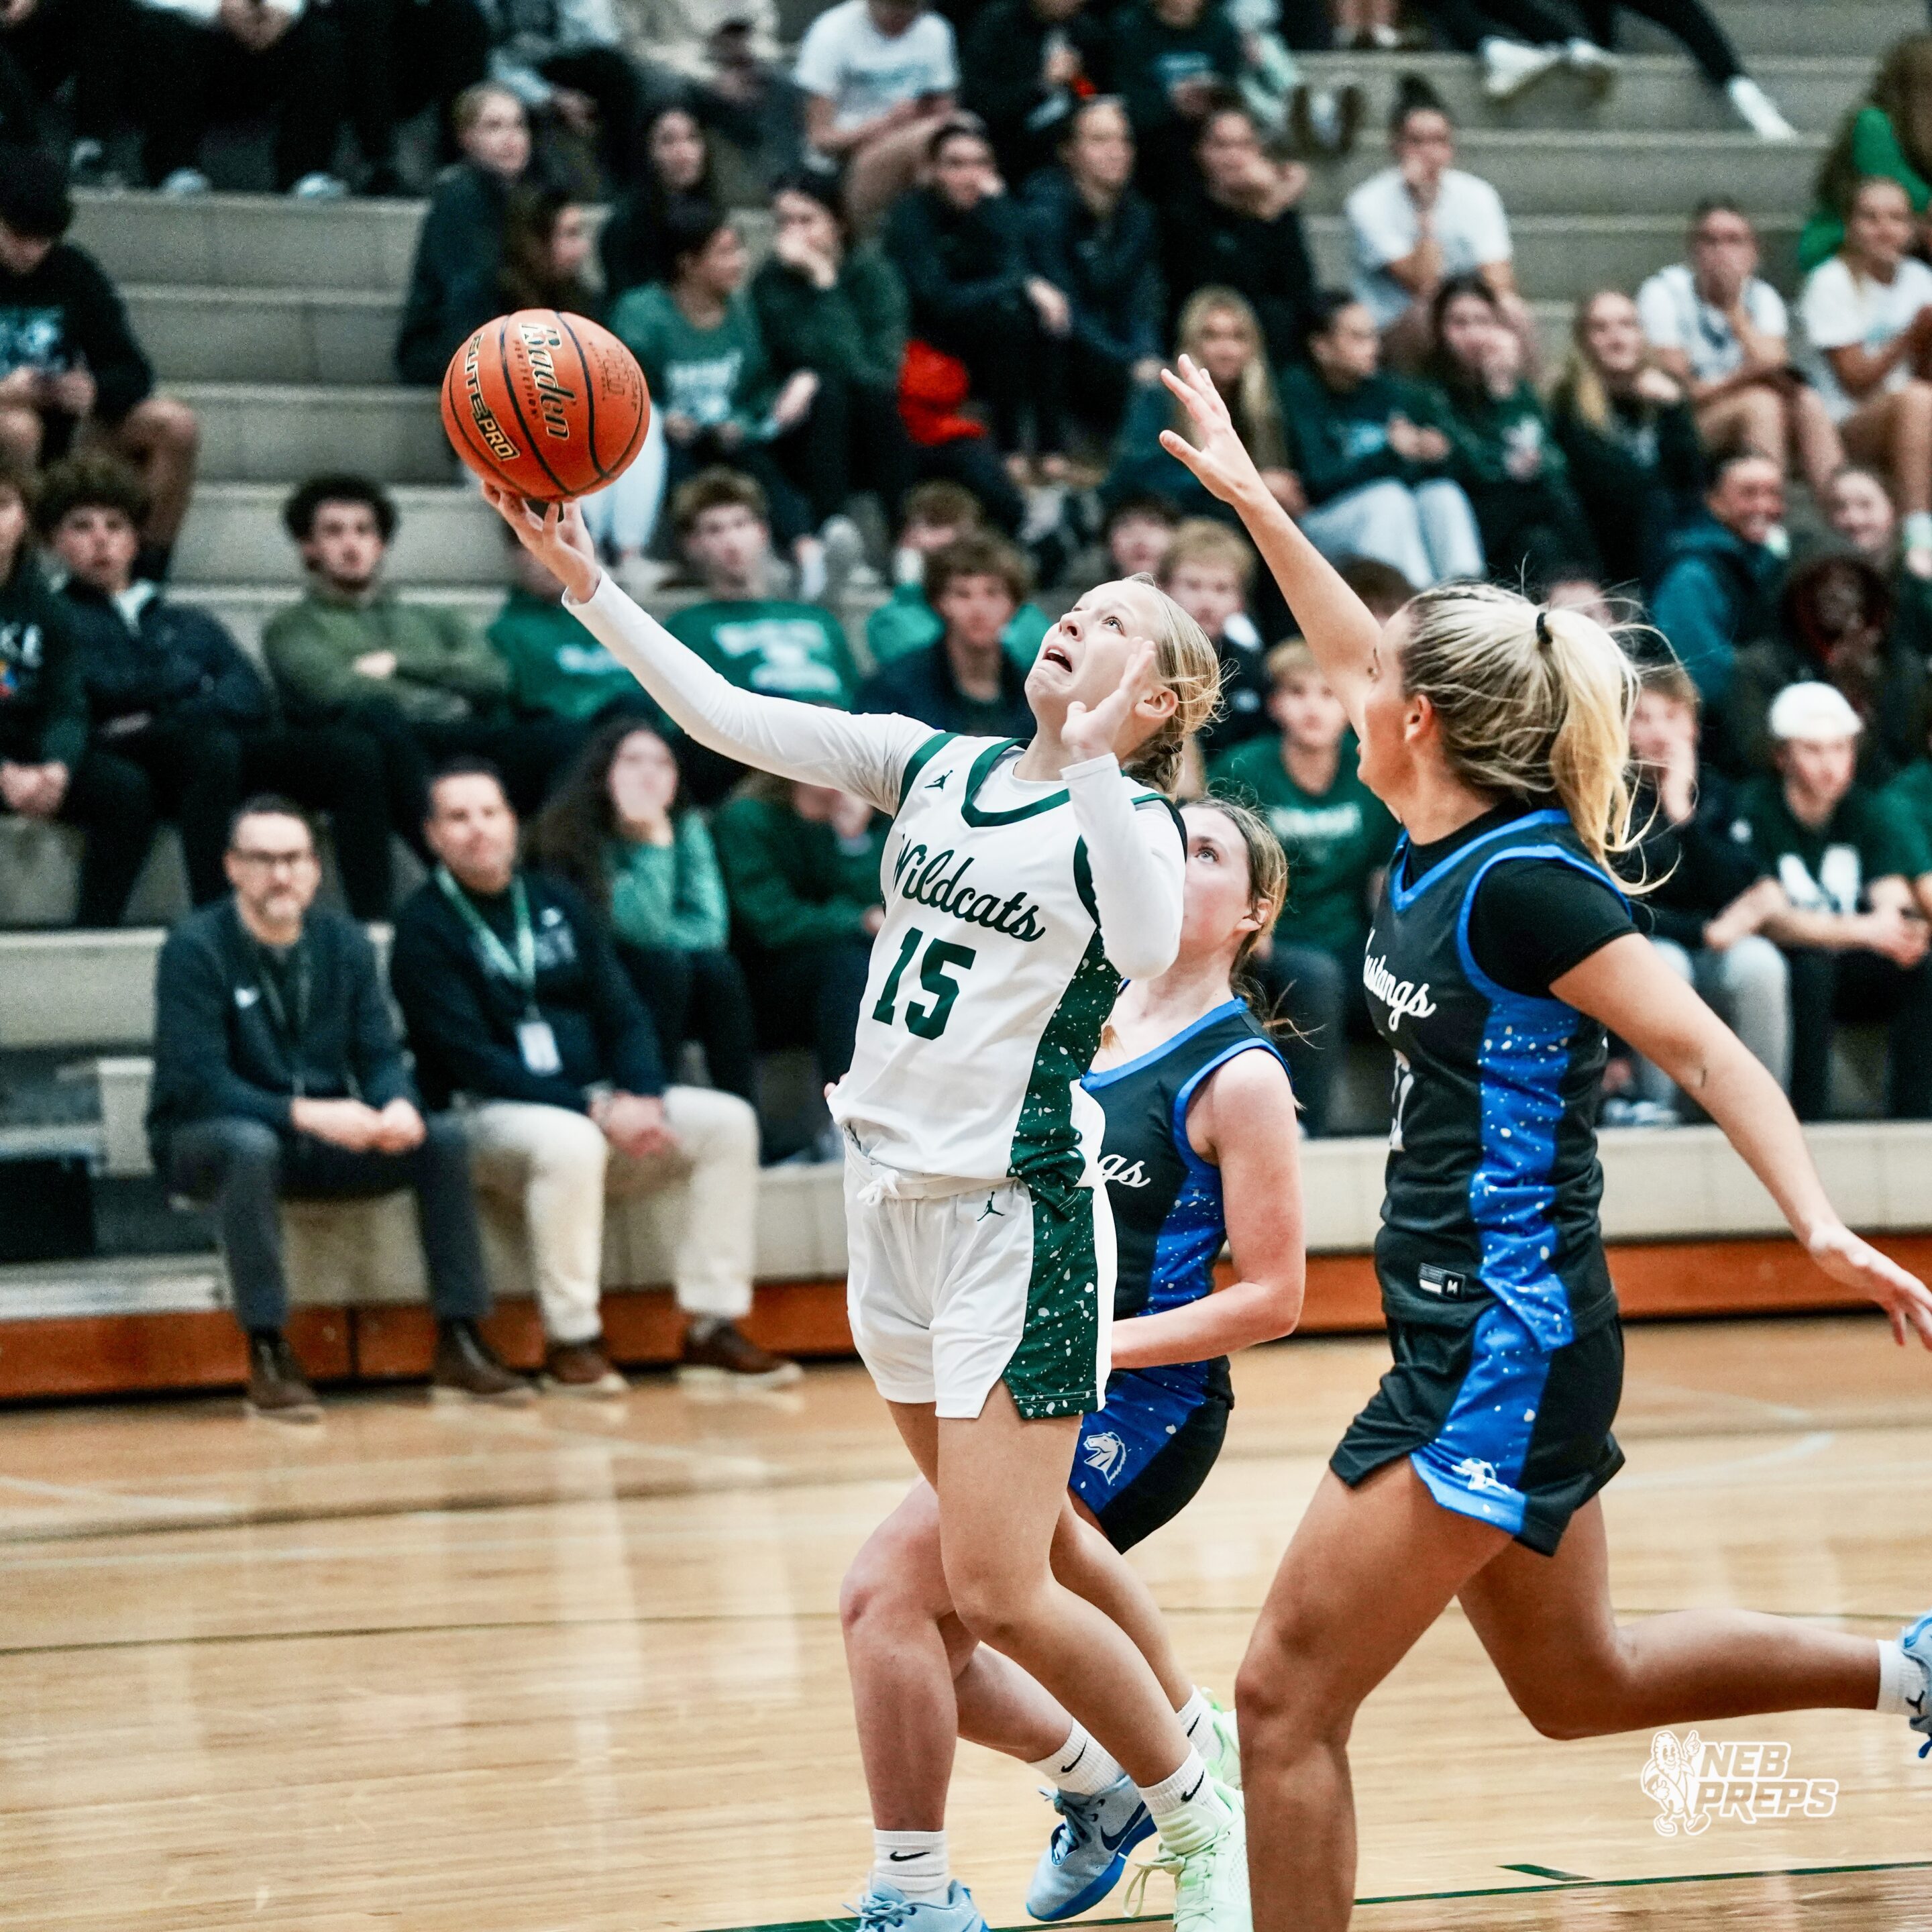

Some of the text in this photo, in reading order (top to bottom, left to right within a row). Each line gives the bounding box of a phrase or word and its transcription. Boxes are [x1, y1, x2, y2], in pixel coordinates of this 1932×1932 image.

[464, 333, 515, 458] ELITE PRO
[519, 322, 576, 440] Baden
[893, 834, 1046, 942] Wildcats
[872, 927, 976, 1040] 15
